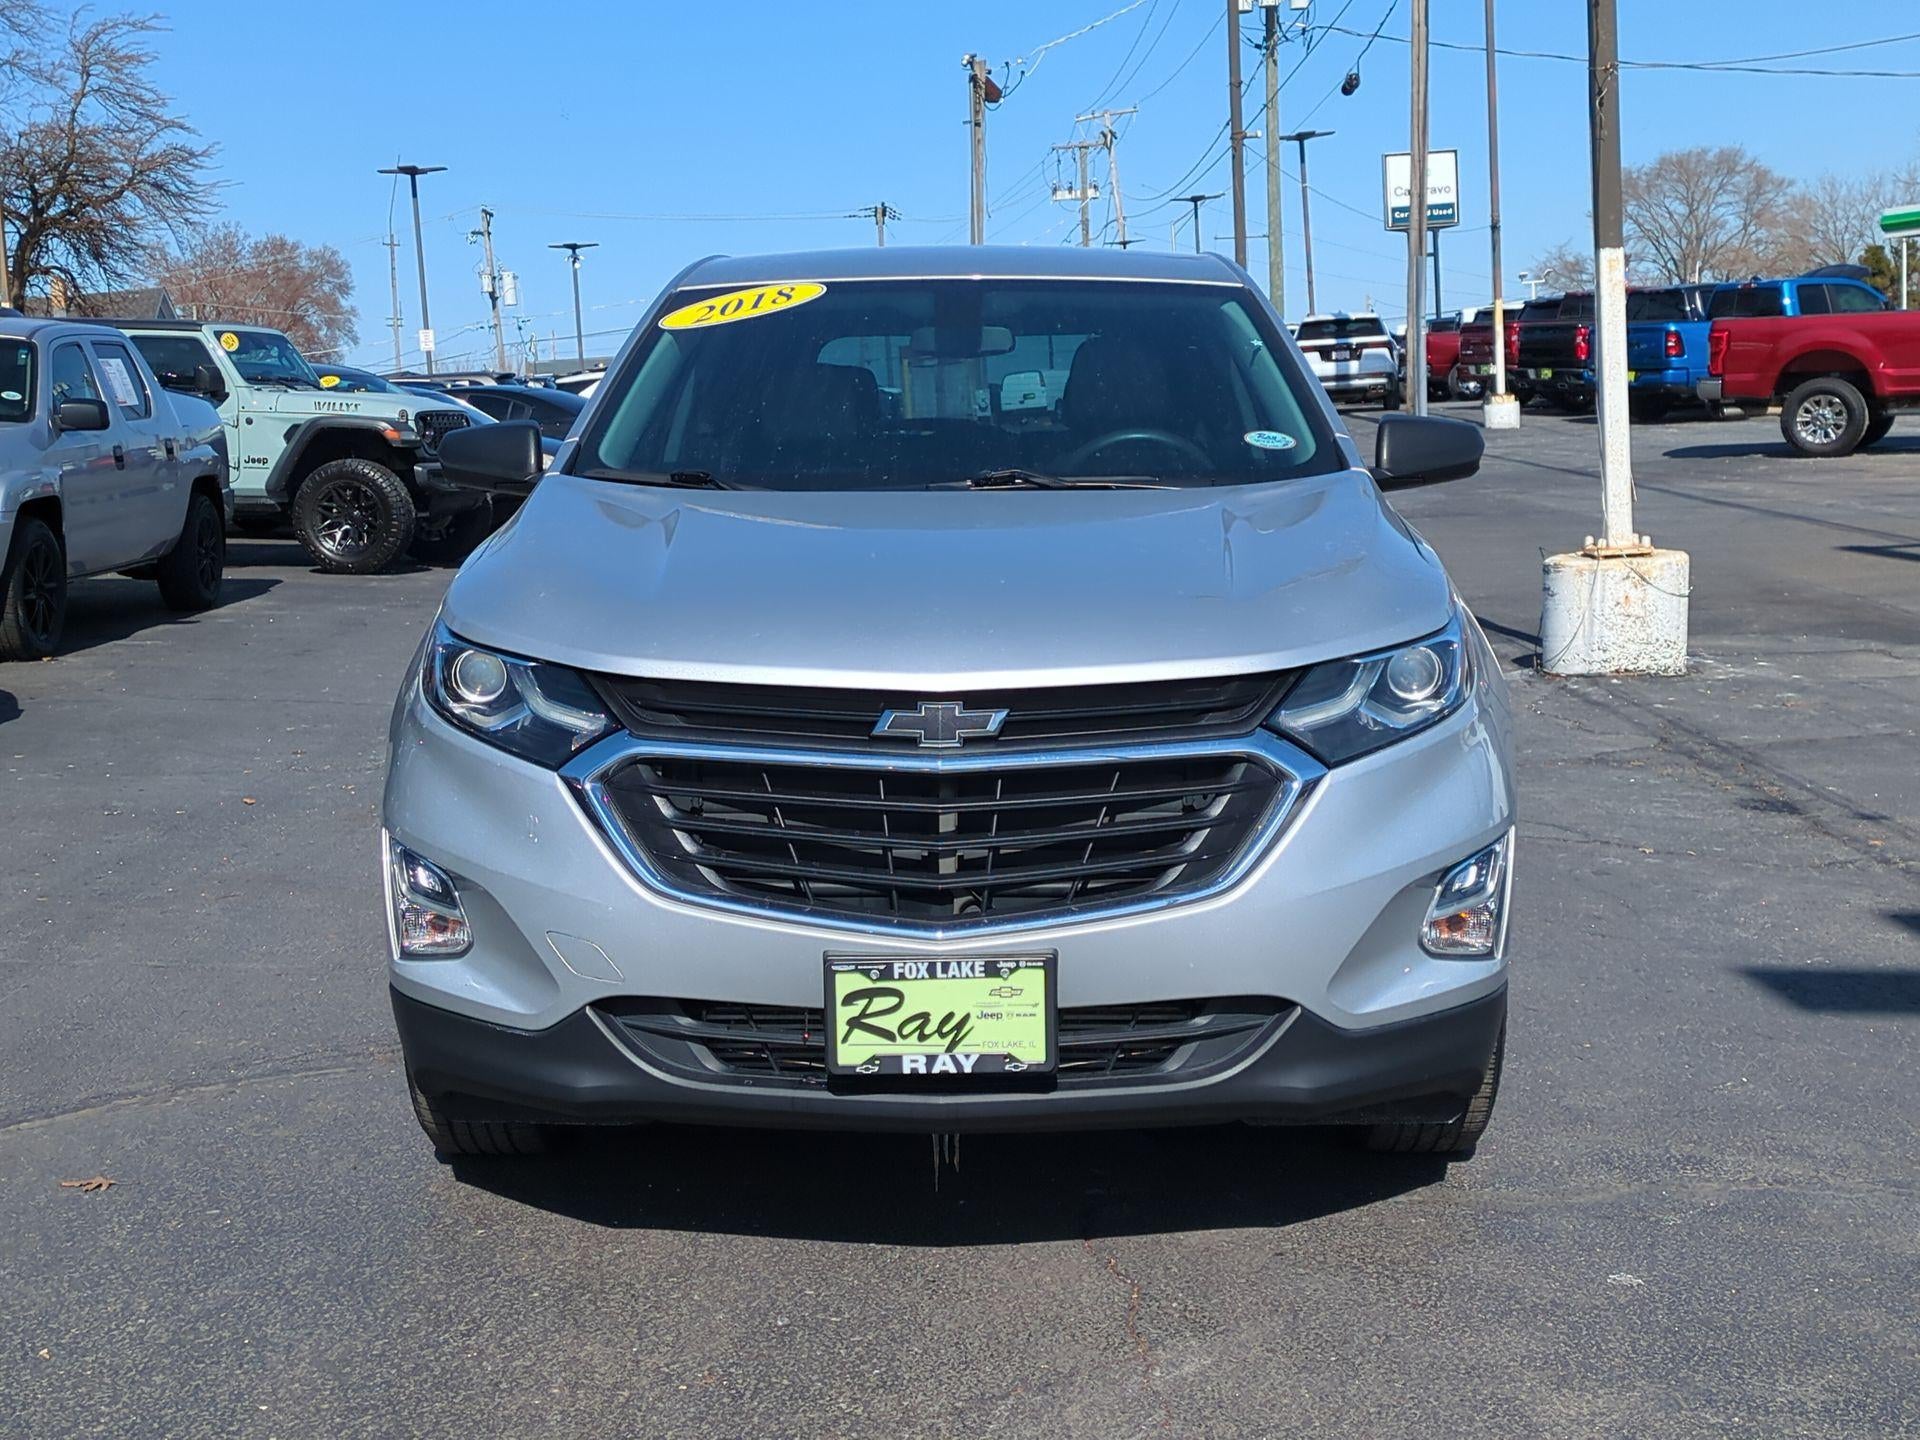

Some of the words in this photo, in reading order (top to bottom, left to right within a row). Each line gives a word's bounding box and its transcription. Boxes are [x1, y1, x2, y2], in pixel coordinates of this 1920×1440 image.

[1432, 207, 1453, 216] Used
[691, 286, 796, 324] 2018
[313, 400, 361, 412] WILLYS
[244, 455, 269, 466] Jeep
[893, 961, 930, 980] FOX
[936, 961, 986, 979] LAKE
[996, 961, 1017, 969] Jeep
[840, 986, 975, 1054] Ray
[976, 1010, 1003, 1021] Jeep
[982, 1040, 1000, 1049] FOX
[901, 1053, 981, 1075] RAY
